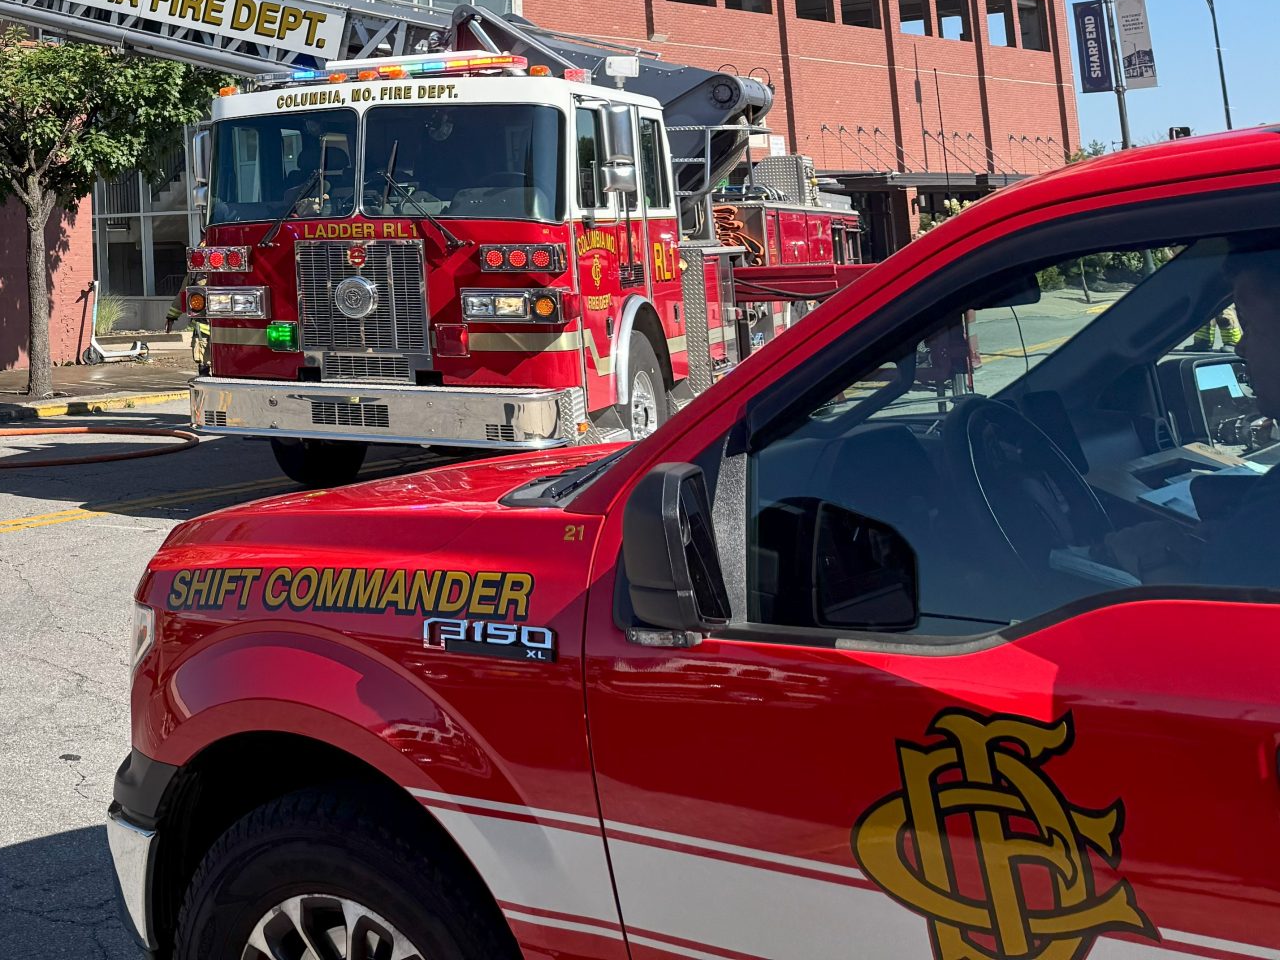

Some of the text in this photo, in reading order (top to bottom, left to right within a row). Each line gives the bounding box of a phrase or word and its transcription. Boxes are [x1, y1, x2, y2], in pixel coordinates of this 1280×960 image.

[1084, 15, 1102, 78] SHARP END
[276, 84, 459, 109] COLUMBIA, MO. FIRE DEPT.
[304, 222, 418, 238] LADDER RL1
[653, 242, 676, 282] RL1
[563, 525, 585, 541] 21
[167, 566, 535, 622] SHIFT COMMANDER
[526, 650, 546, 660] XL
